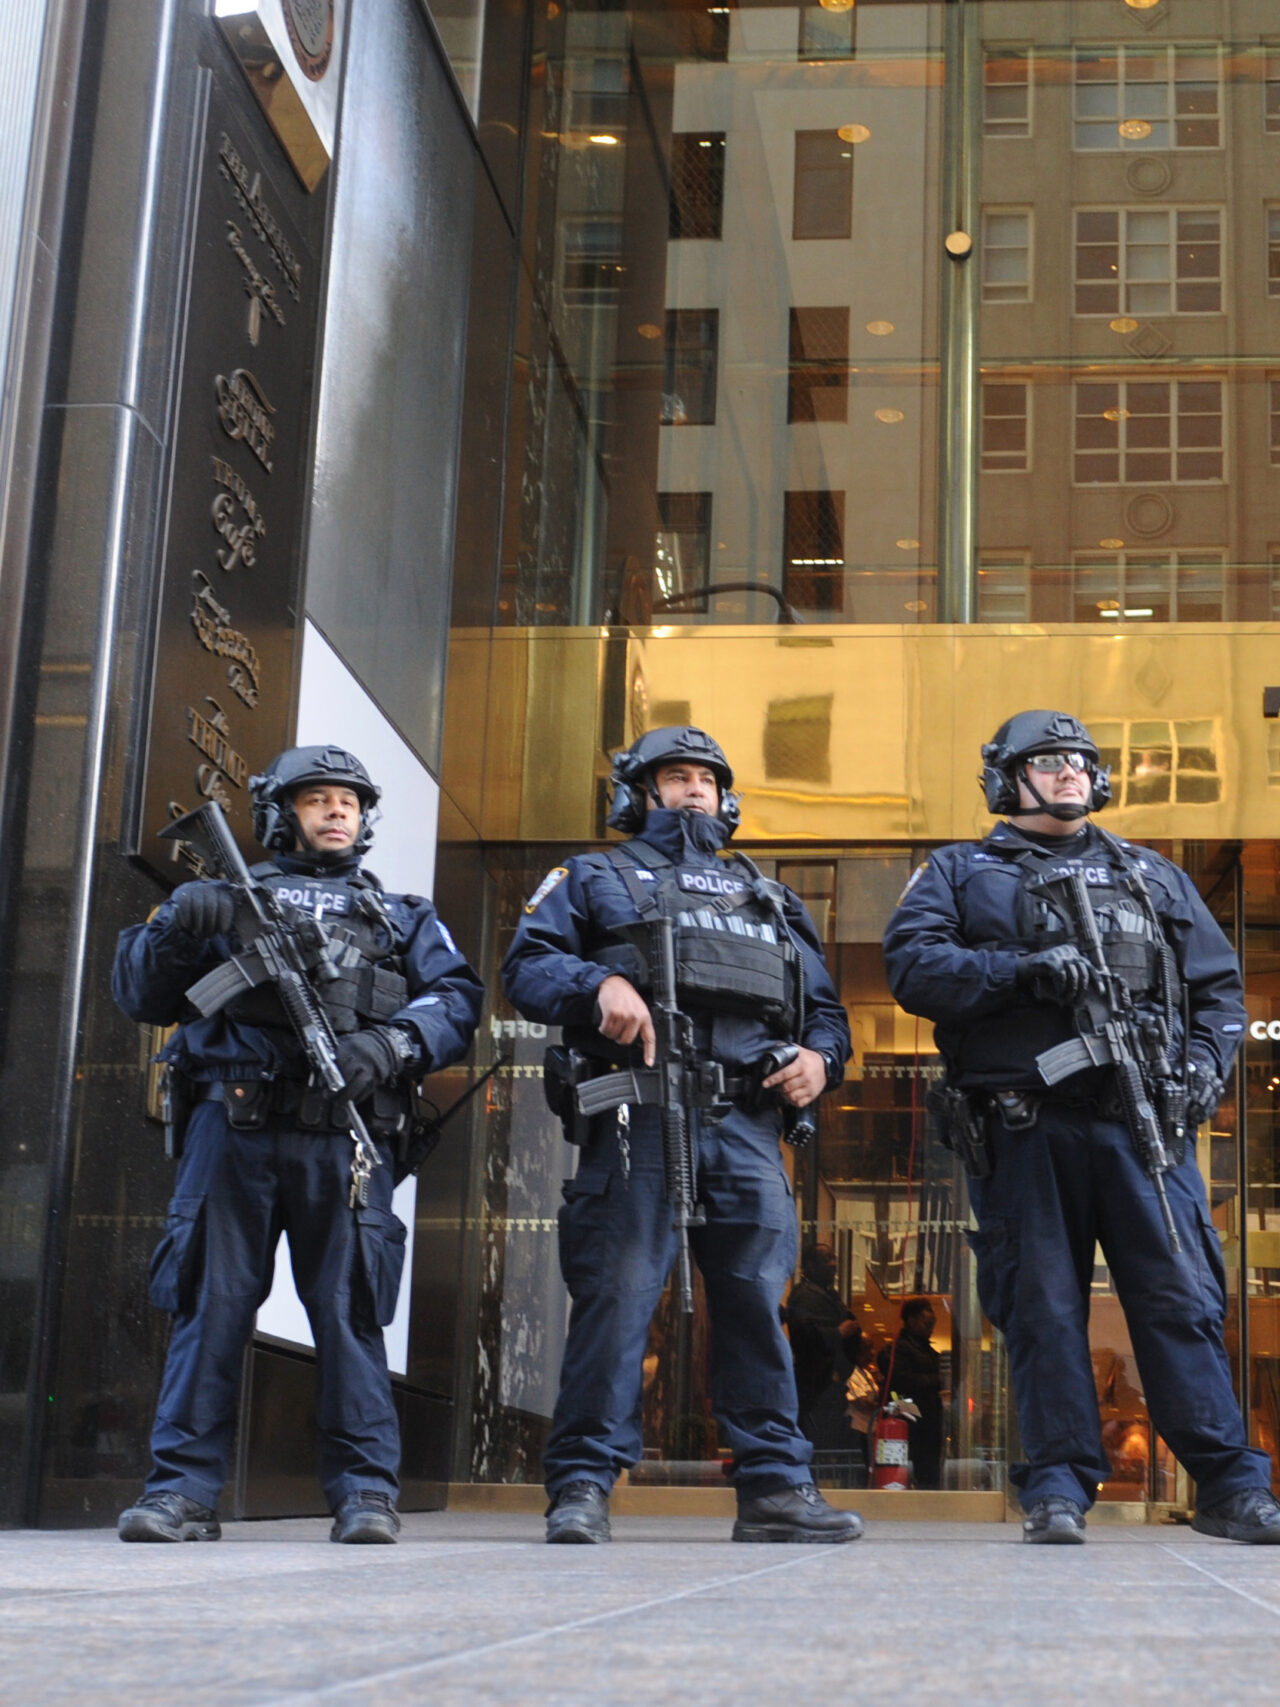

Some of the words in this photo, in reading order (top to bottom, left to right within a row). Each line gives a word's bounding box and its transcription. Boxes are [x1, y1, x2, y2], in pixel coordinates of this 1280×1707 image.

[186, 706, 249, 788] TRUMP
[682, 873, 745, 895] POLICE
[277, 887, 346, 911] POLICE
